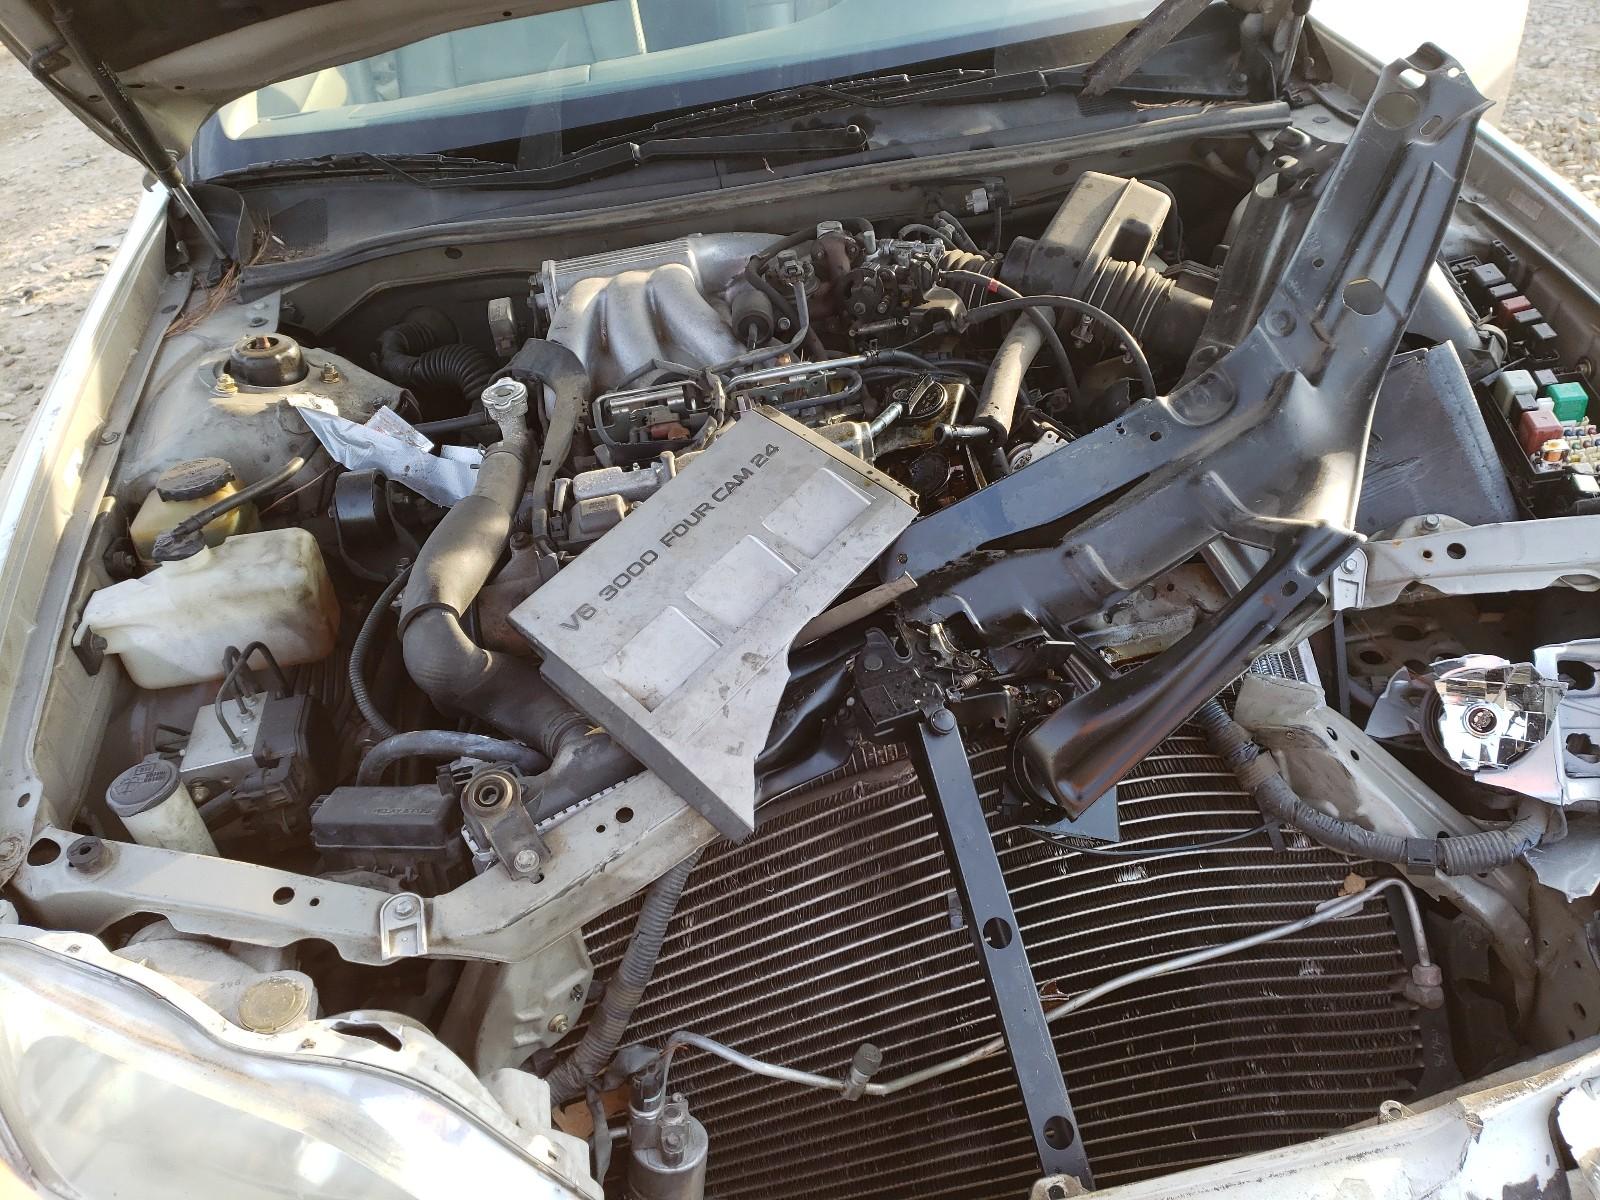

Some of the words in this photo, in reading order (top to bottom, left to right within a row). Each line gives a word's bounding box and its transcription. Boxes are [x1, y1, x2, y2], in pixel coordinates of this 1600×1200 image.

[560, 603, 597, 631] V6
[599, 549, 659, 601] 3000
[660, 502, 715, 548] FOUR
[711, 467, 754, 502] CAM
[750, 443, 780, 468] 24
